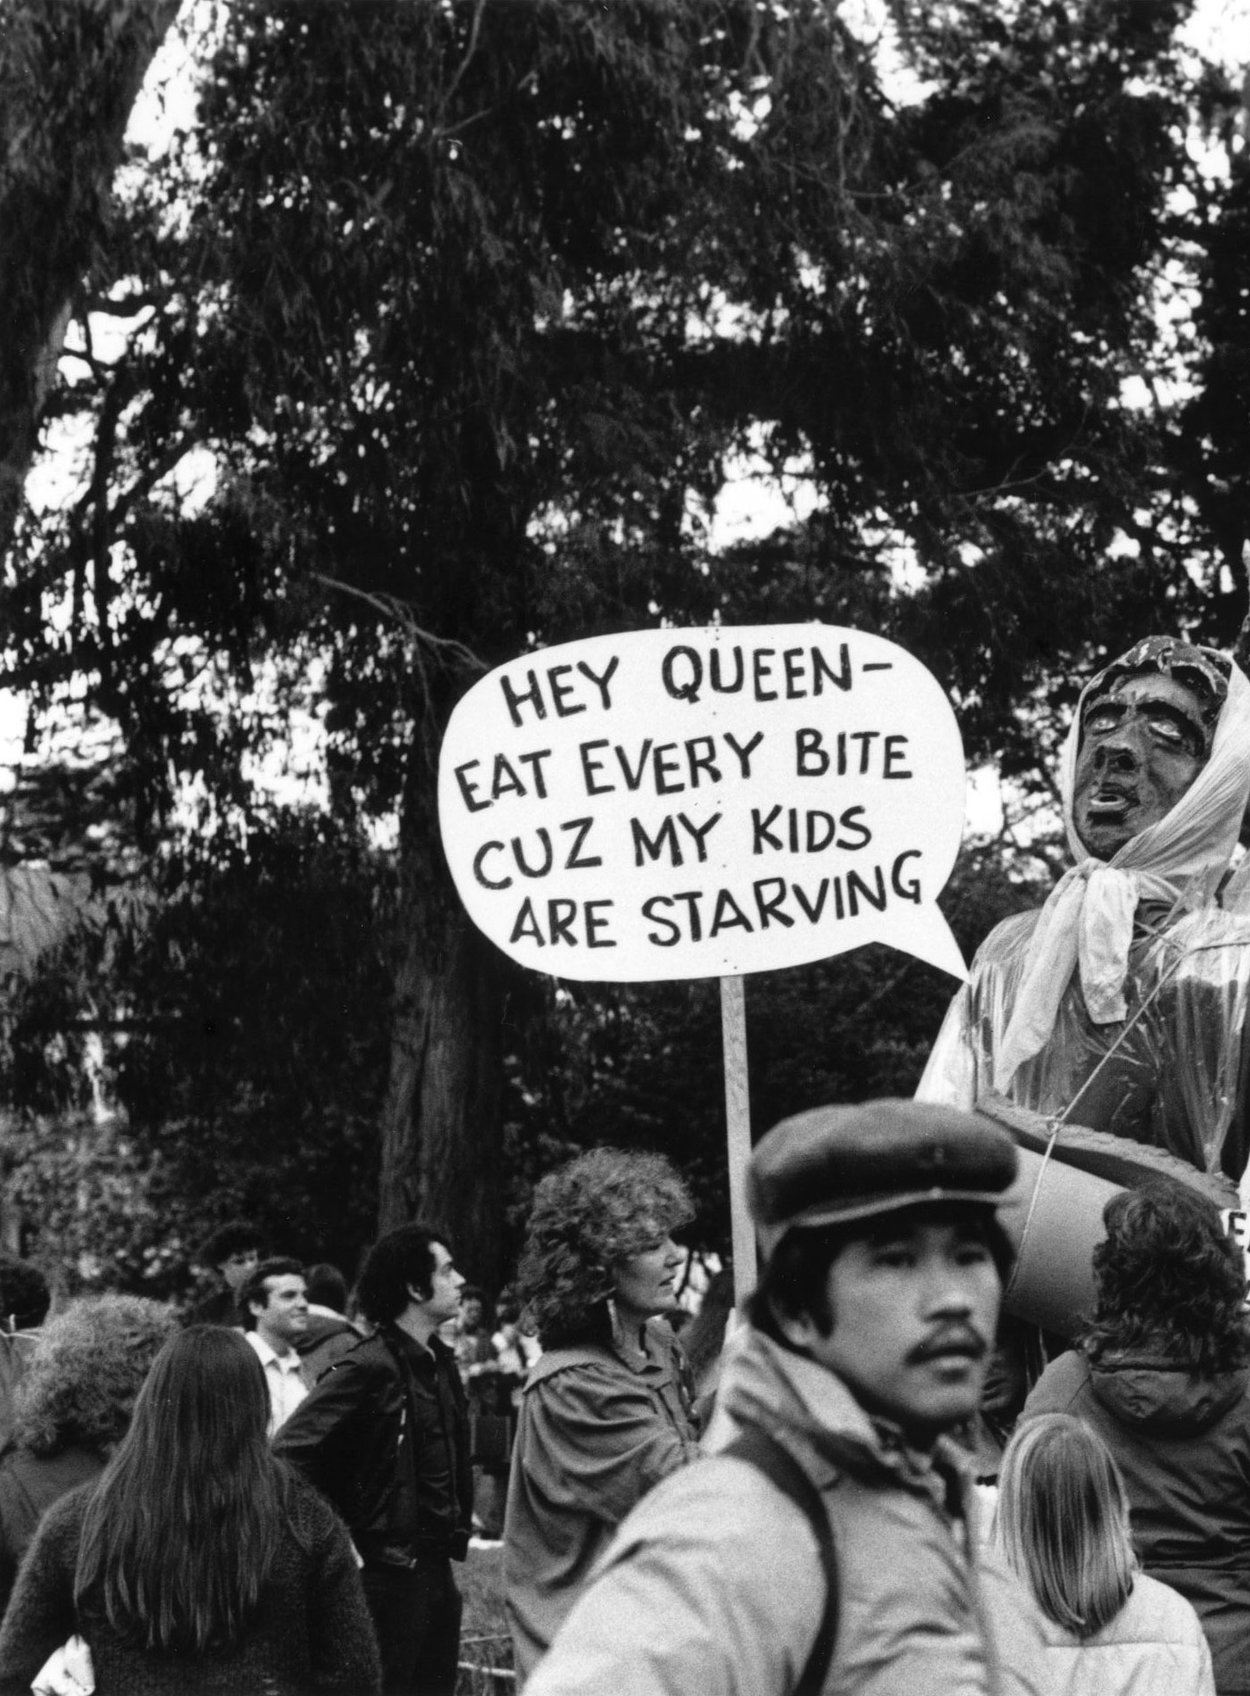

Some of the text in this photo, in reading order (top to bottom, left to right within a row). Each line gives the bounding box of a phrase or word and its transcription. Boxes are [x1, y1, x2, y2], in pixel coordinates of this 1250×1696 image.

[500, 655, 619, 728] HEY
[454, 727, 913, 813] EAT EVERY BITE
[473, 804, 872, 890] CUZ MY KIDS
[509, 849, 922, 949] ARE STARVING
